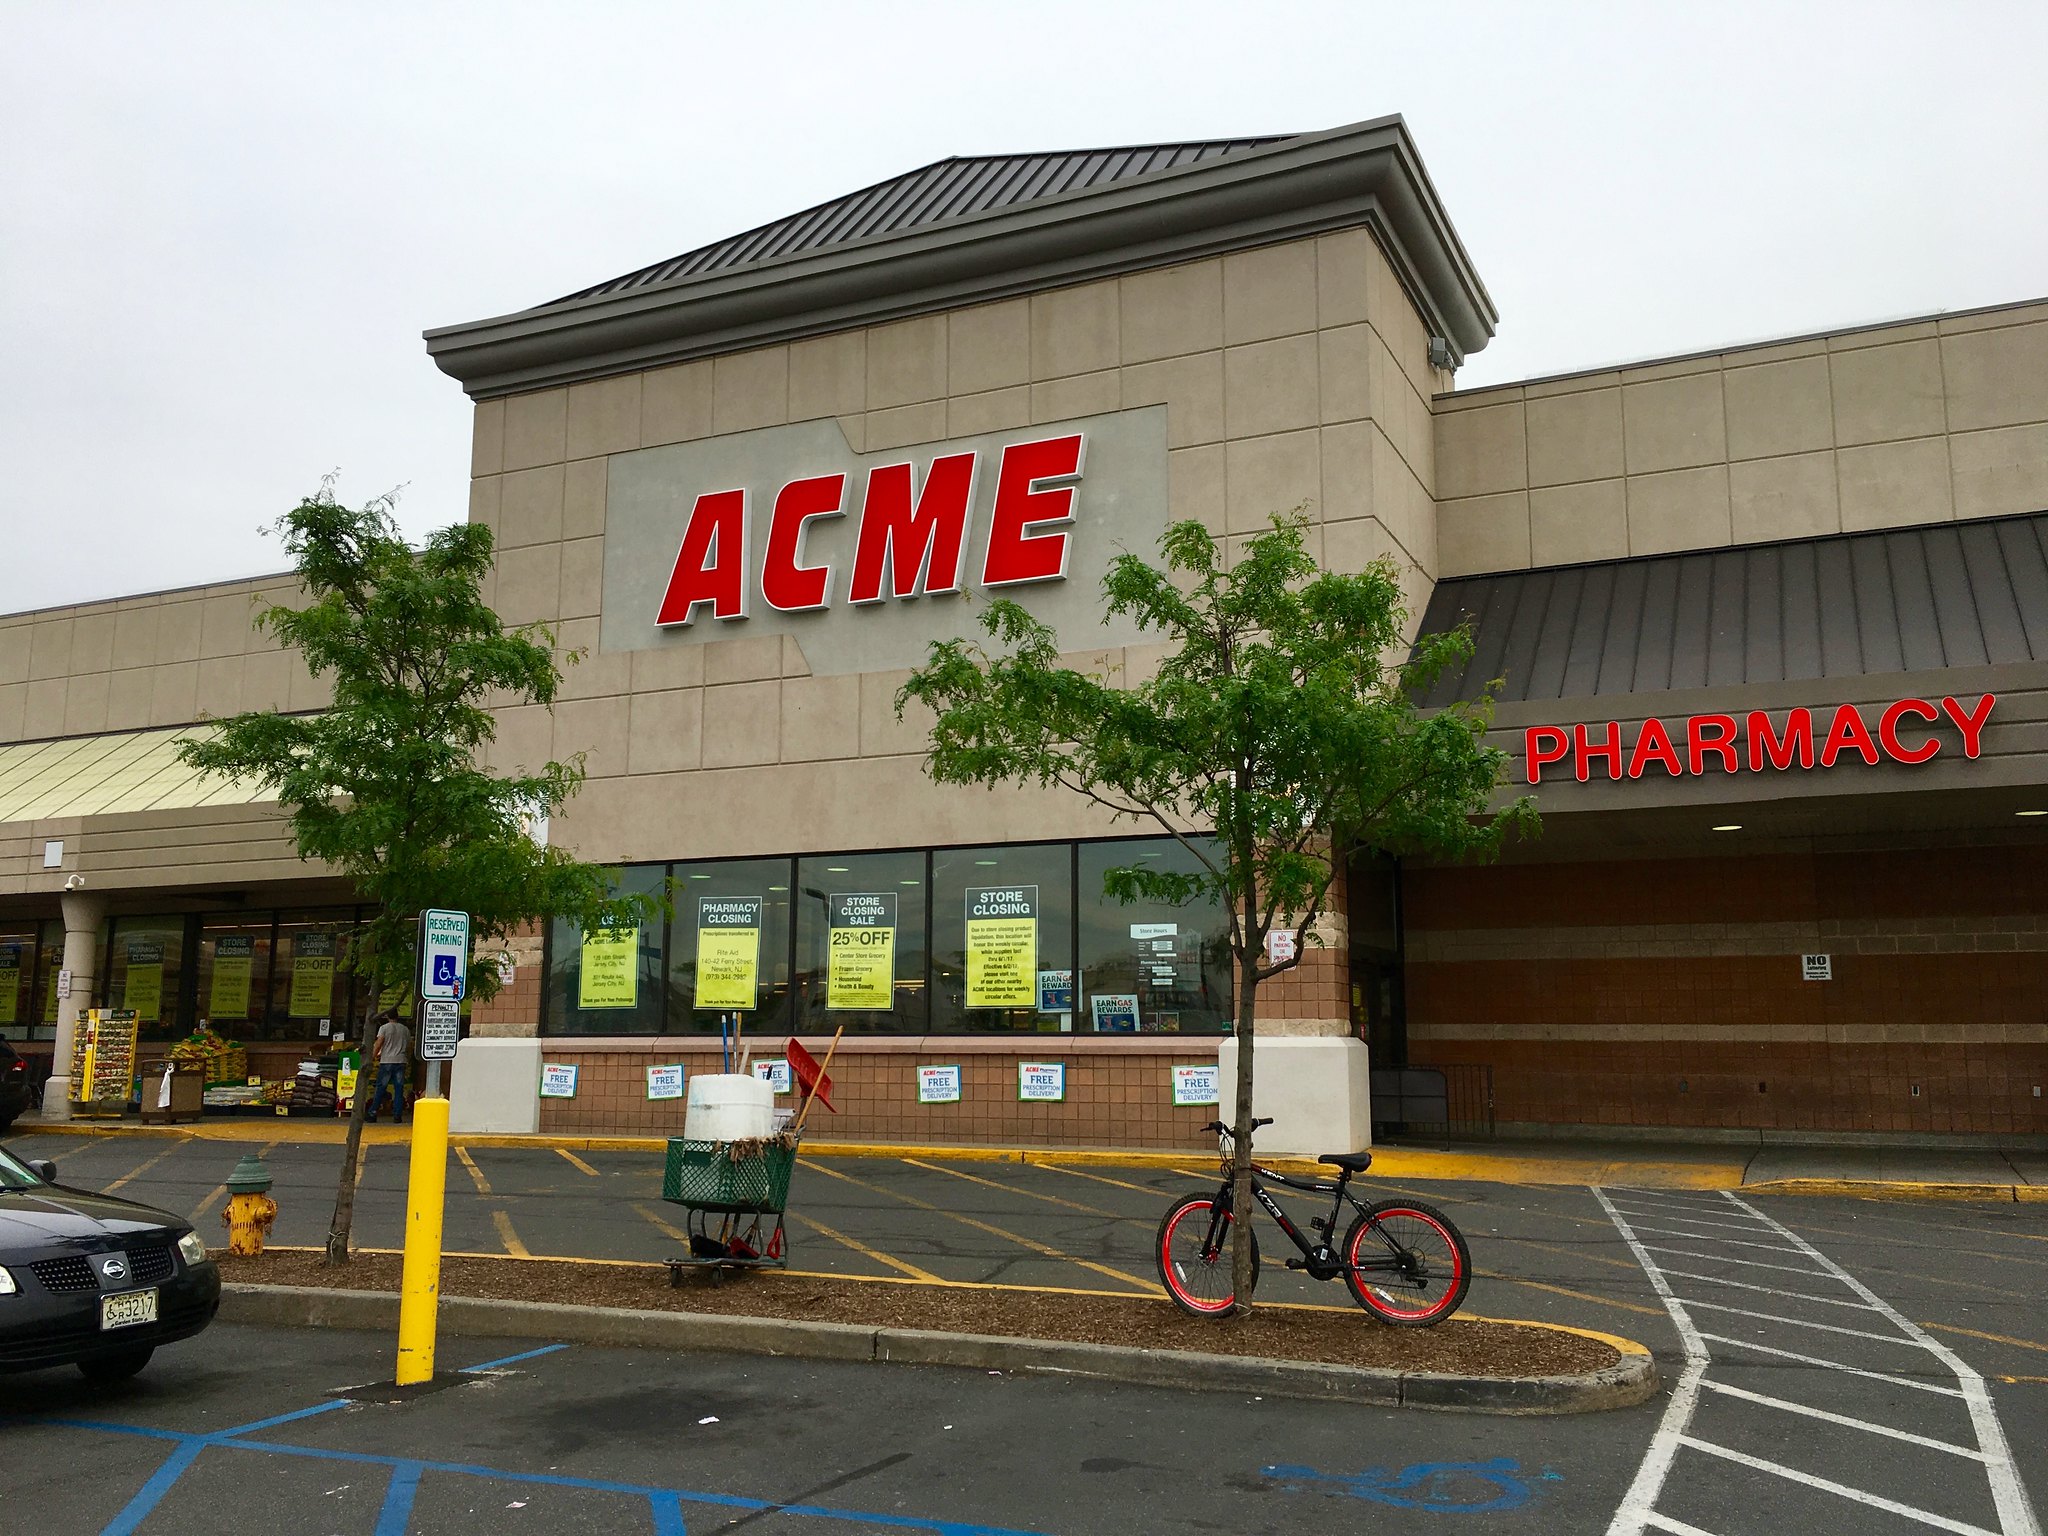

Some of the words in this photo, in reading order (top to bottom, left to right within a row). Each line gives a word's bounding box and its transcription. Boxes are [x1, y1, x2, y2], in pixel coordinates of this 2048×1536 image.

[654, 432, 1090, 630] ACME
[1525, 693, 1996, 785] PHARMACY
[846, 897, 880, 906] STORE
[980, 891, 1023, 903] STORE
[702, 903, 758, 913] PHARMACY
[841, 906, 885, 915] CLOSING
[973, 903, 1030, 916] CLOSING
[708, 914, 752, 923] CLOSING
[849, 916, 875, 925] SALE
[429, 918, 466, 932] RESERVED
[222, 938, 247, 947] STORE
[305, 934, 327, 942] STORE
[431, 933, 462, 946] PARKING
[860, 931, 890, 945] OFF
[301, 941, 329, 949] CLOSING
[218, 946, 250, 955] CLOSING
[306, 948, 323, 956] SALE
[132, 953, 159, 961] CLOSING
[868, 952, 886, 960] Grocery
[312, 958, 332, 970] OFF
[1806, 956, 1827, 966] NO
[1042, 975, 1062, 983] EARN
[550, 1074, 568, 1083] FREE
[655, 1076, 675, 1085] FREE
[927, 1077, 950, 1087] FREE
[1030, 1075, 1053, 1084] FREE
[1184, 1078, 1210, 1088] FREE
